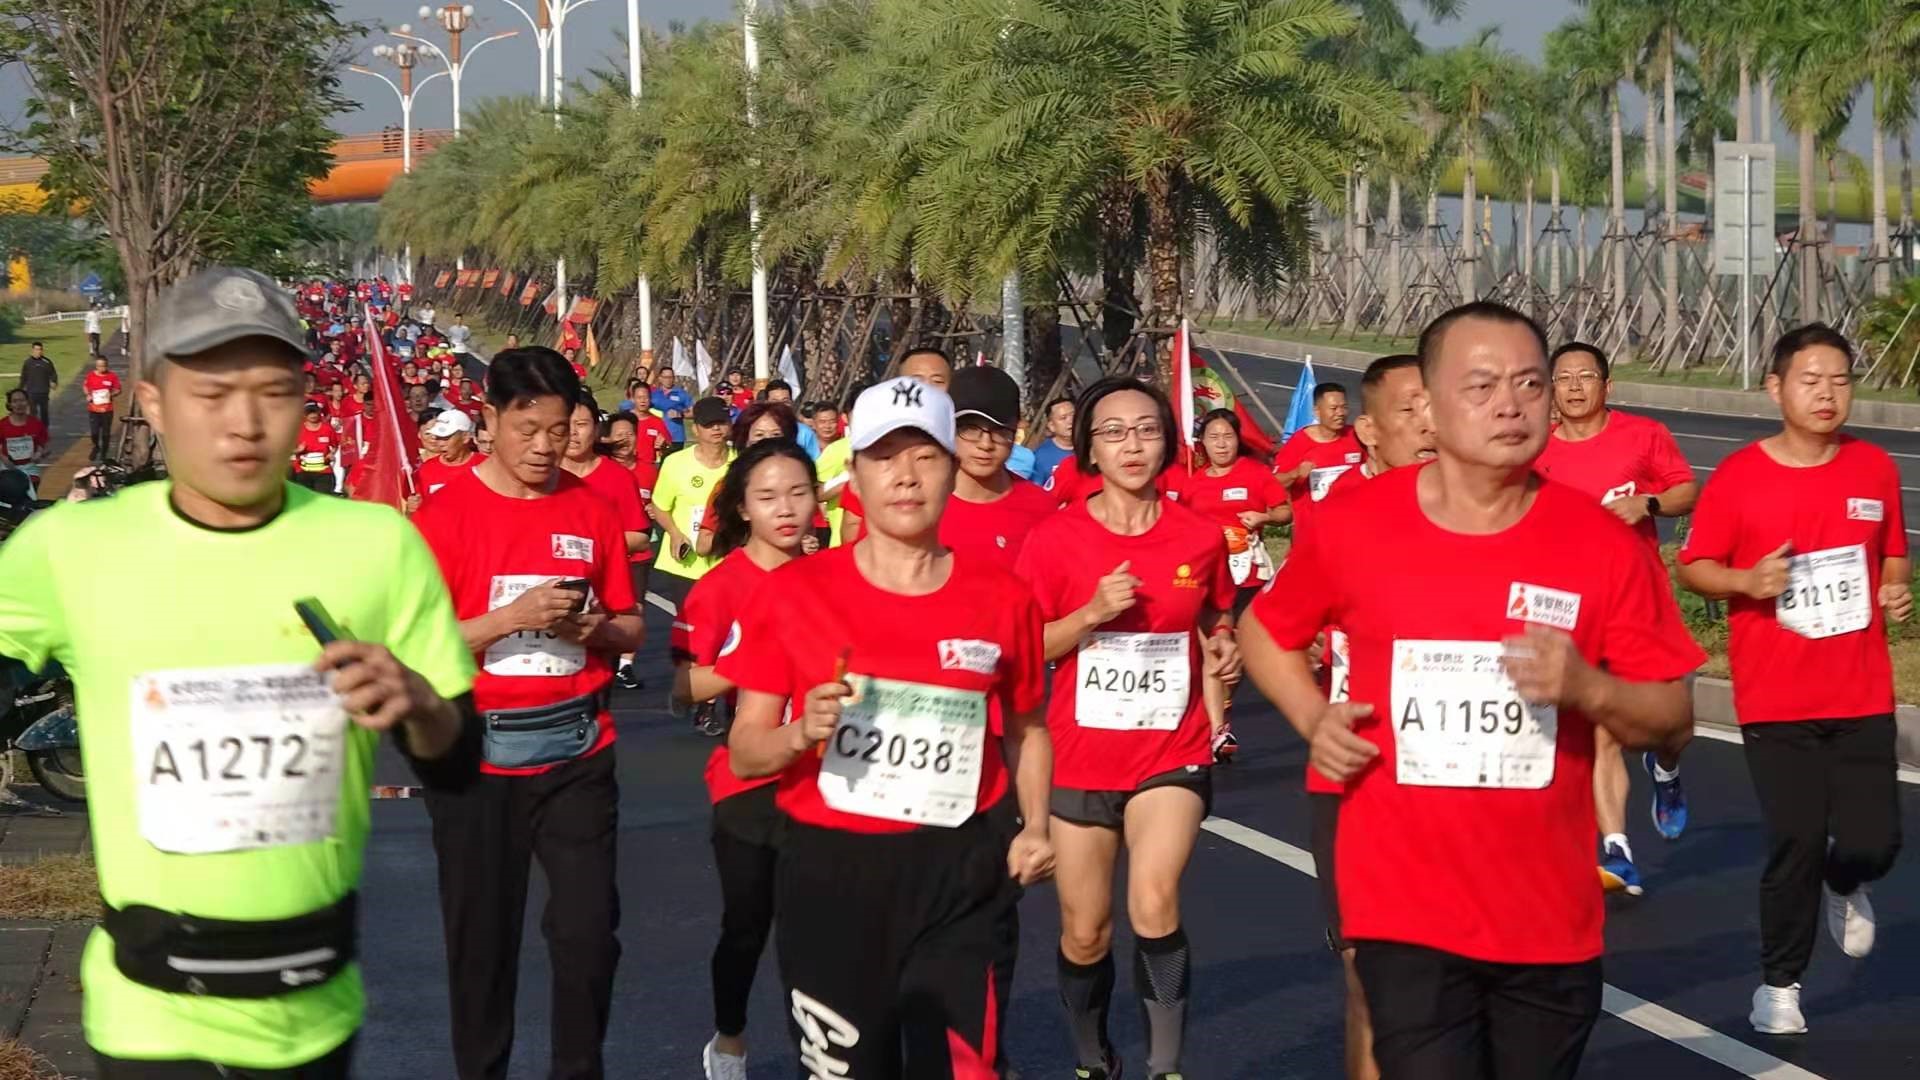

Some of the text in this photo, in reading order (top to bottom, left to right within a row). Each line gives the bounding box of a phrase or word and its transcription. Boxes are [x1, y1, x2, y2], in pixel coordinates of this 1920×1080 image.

[891, 381, 924, 408] NY
[1781, 580, 1850, 610] B1219
[1085, 666, 1167, 693] A2045
[1400, 696, 1523, 735] A1159
[149, 733, 307, 785] A1272
[836, 724, 954, 774] C2038
